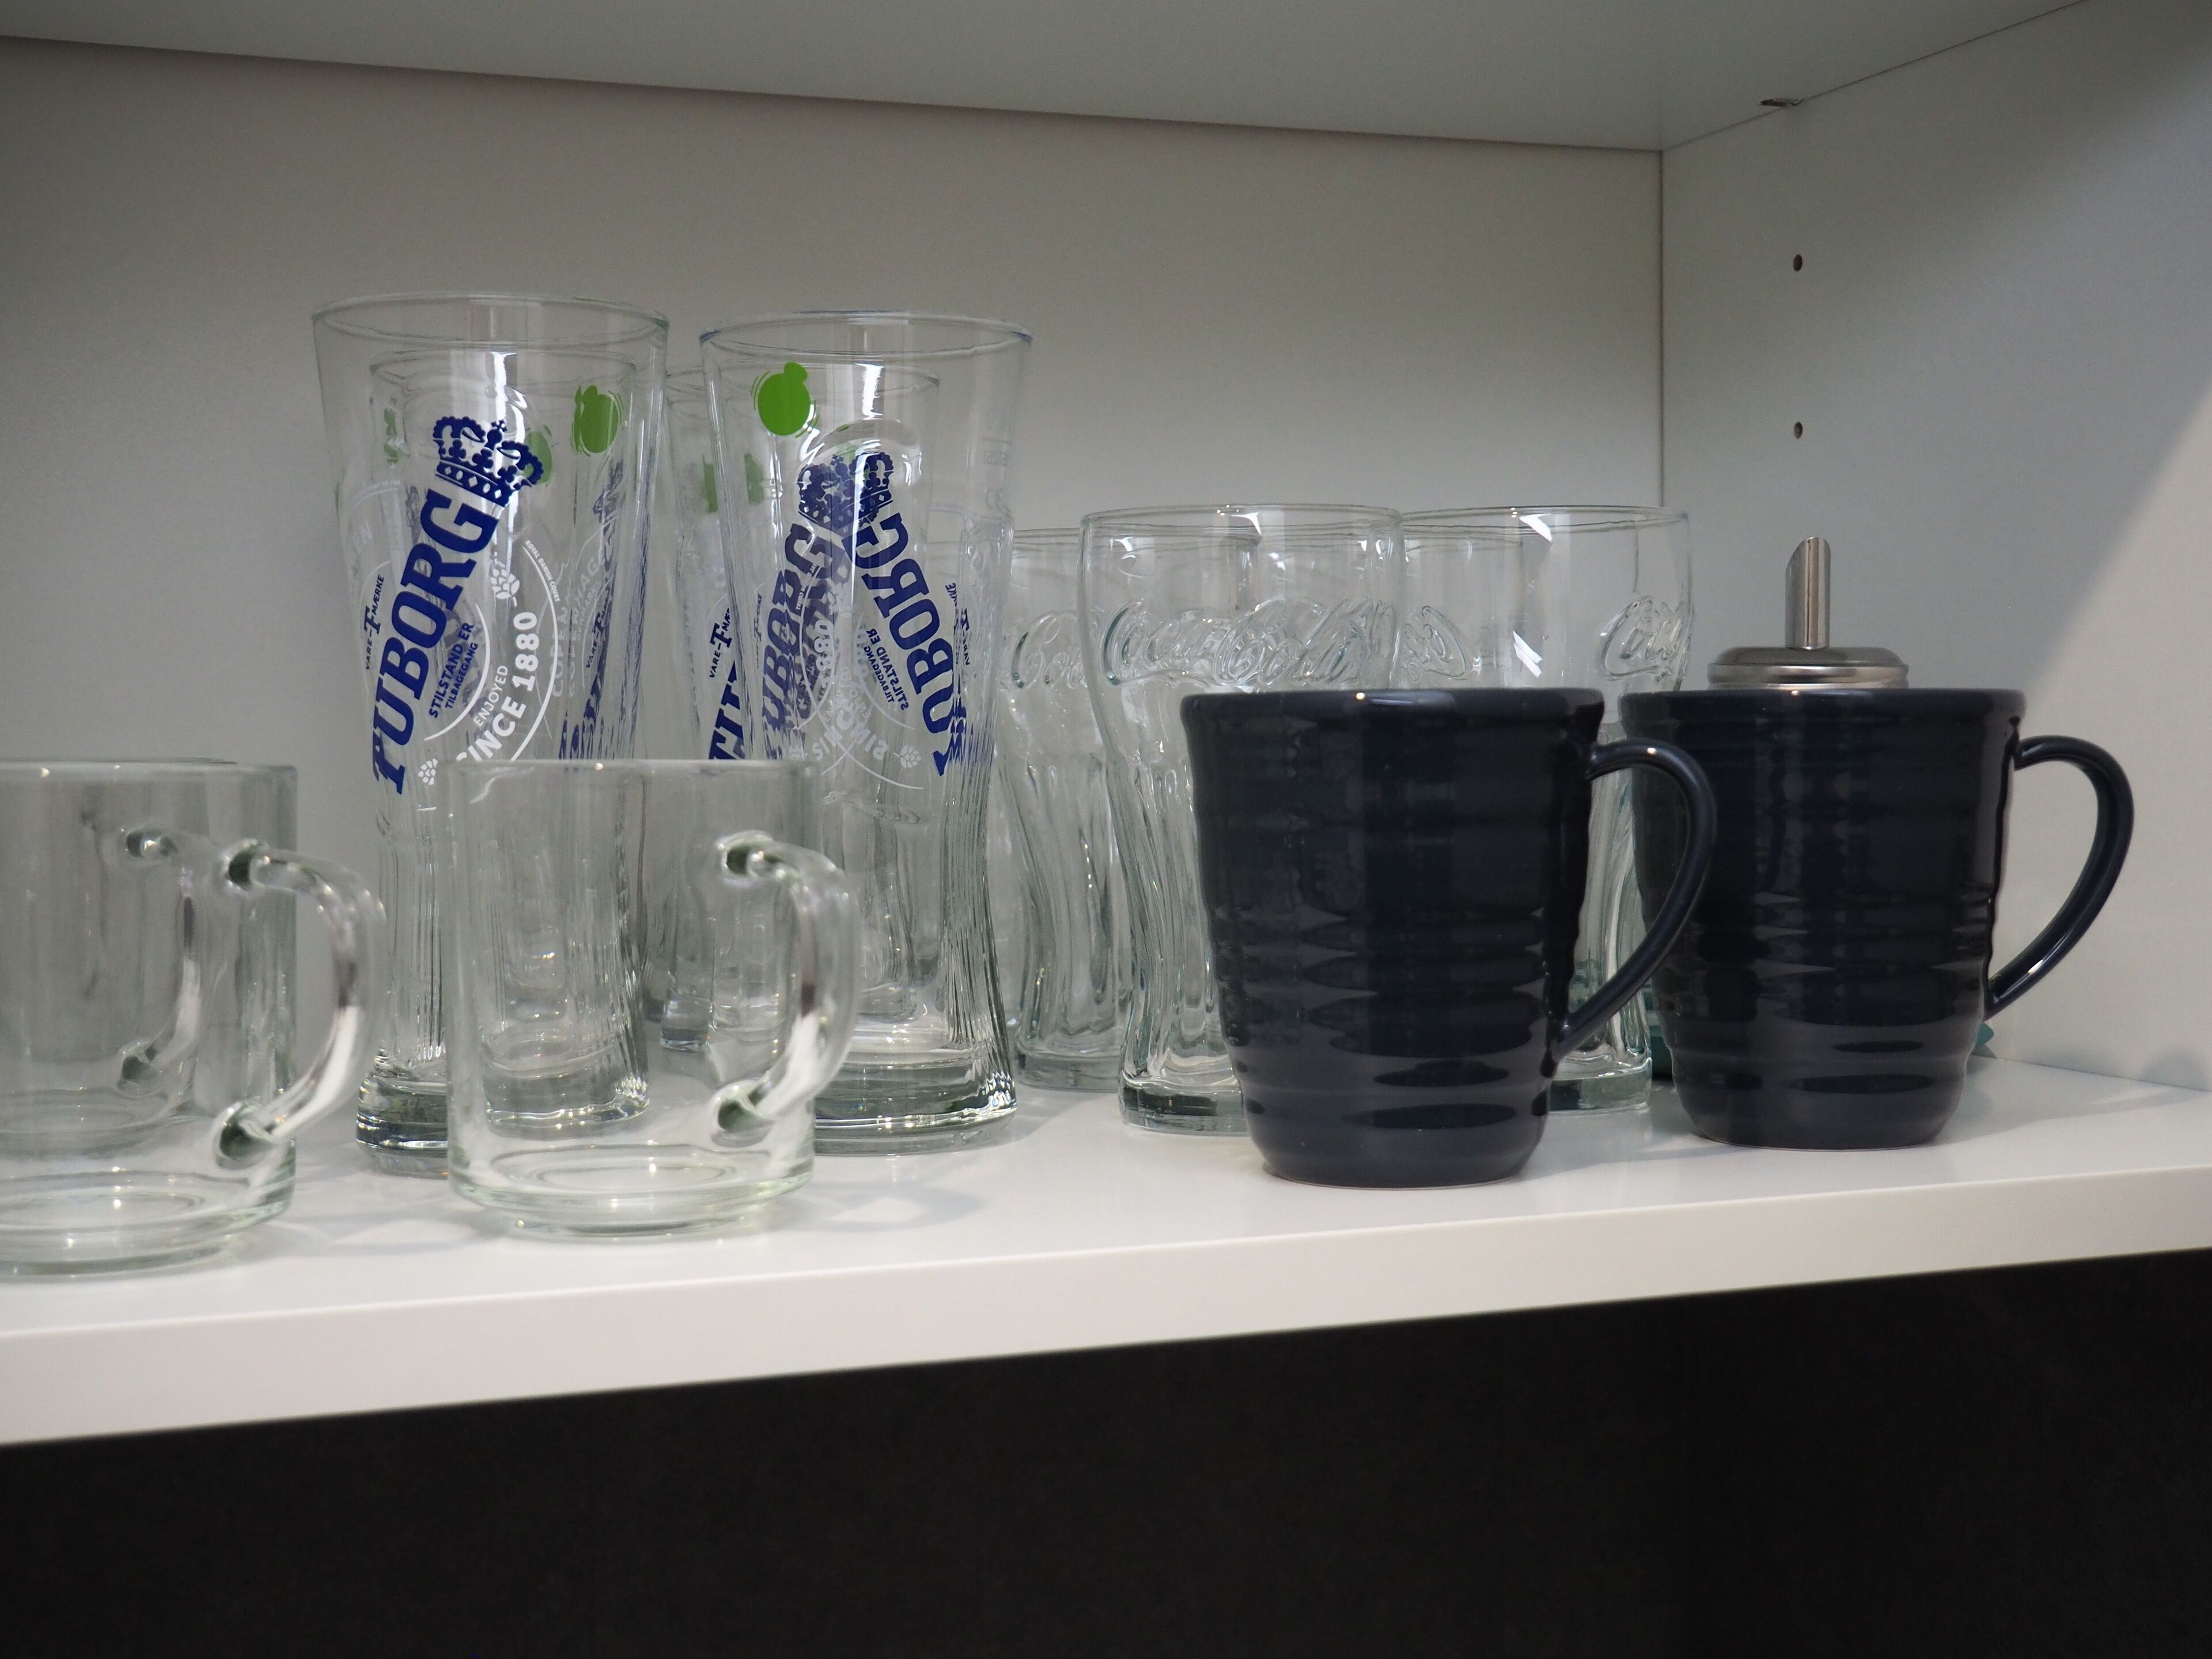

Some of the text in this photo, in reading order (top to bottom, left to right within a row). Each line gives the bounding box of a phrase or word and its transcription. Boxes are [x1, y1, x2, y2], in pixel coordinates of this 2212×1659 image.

[429, 622, 475, 719] STILSTAND ER
[445, 642, 479, 709] TILBAGEGANG
[512, 612, 539, 691] 1880
[474, 665, 508, 727] ENJOYED
